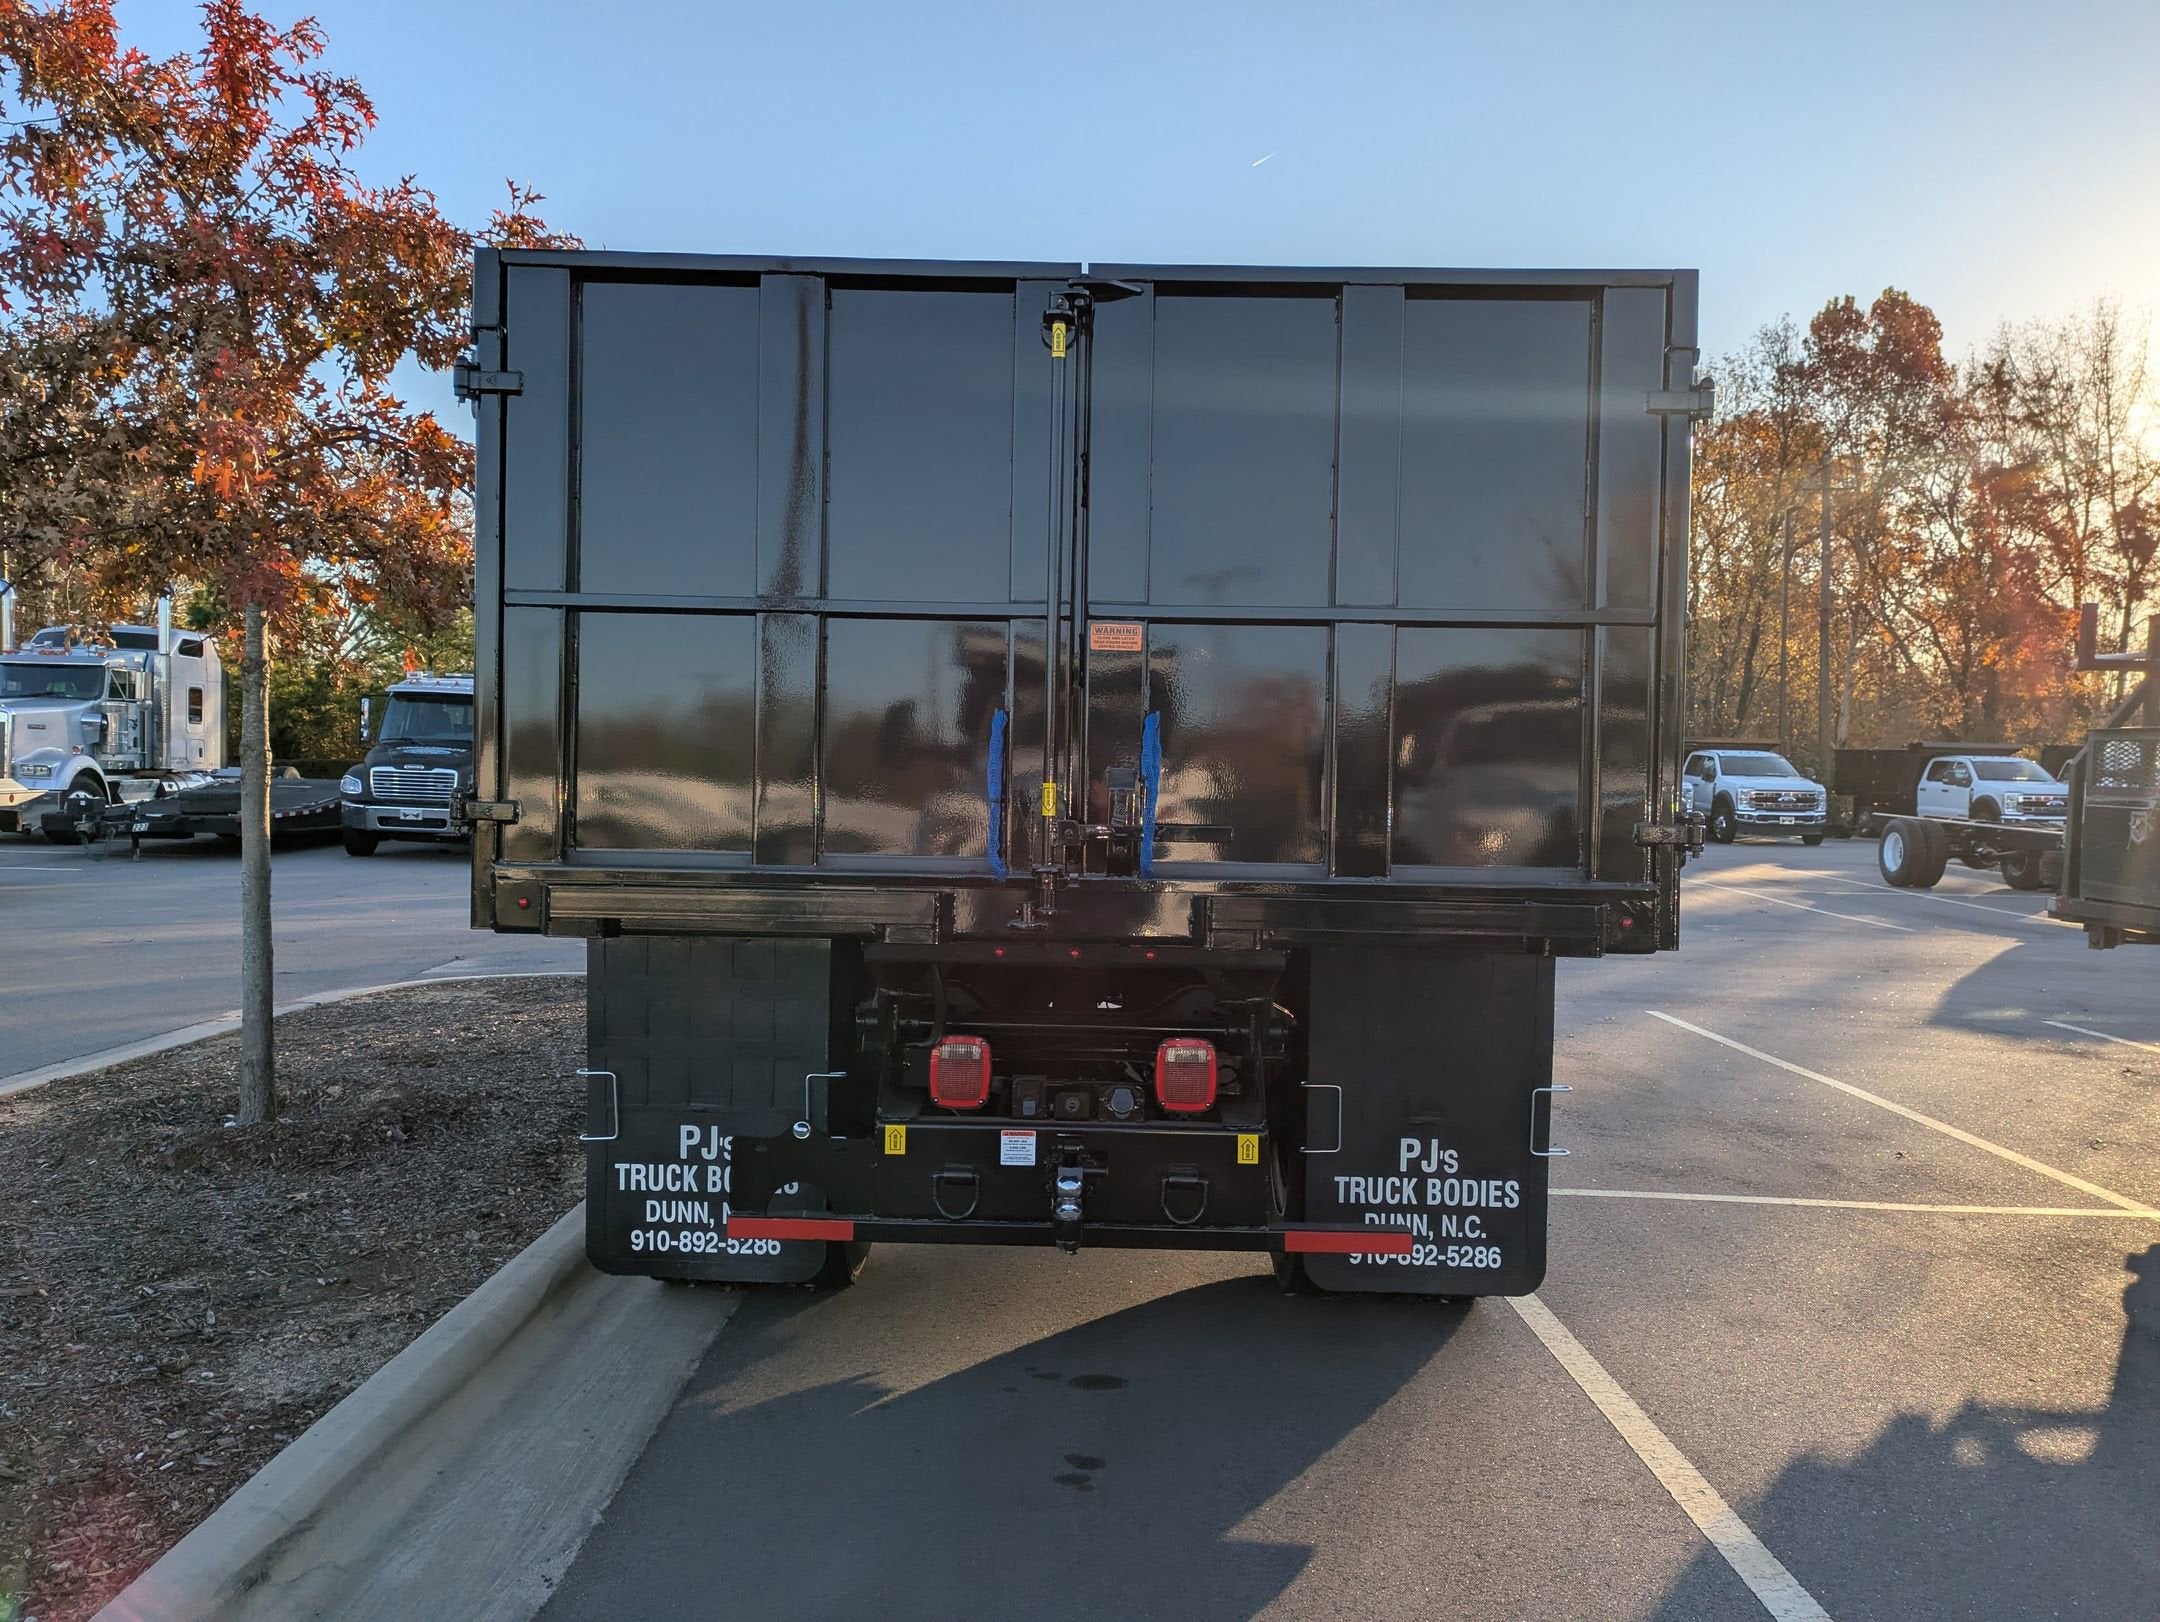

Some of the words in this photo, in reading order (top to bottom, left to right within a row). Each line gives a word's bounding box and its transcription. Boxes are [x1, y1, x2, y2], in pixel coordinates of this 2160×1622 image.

[1095, 627, 1138, 635] WARNING
[1399, 1138, 1459, 1174] PJ's
[615, 1163, 699, 1192] TRUCK
[1334, 1176, 1418, 1205] TRUCK
[1426, 1178, 1520, 1209] BODIES
[645, 1200, 715, 1229] DUNN,
[1442, 1214, 1487, 1239] N.C.
[630, 1229, 782, 1256] 910-892-5286
